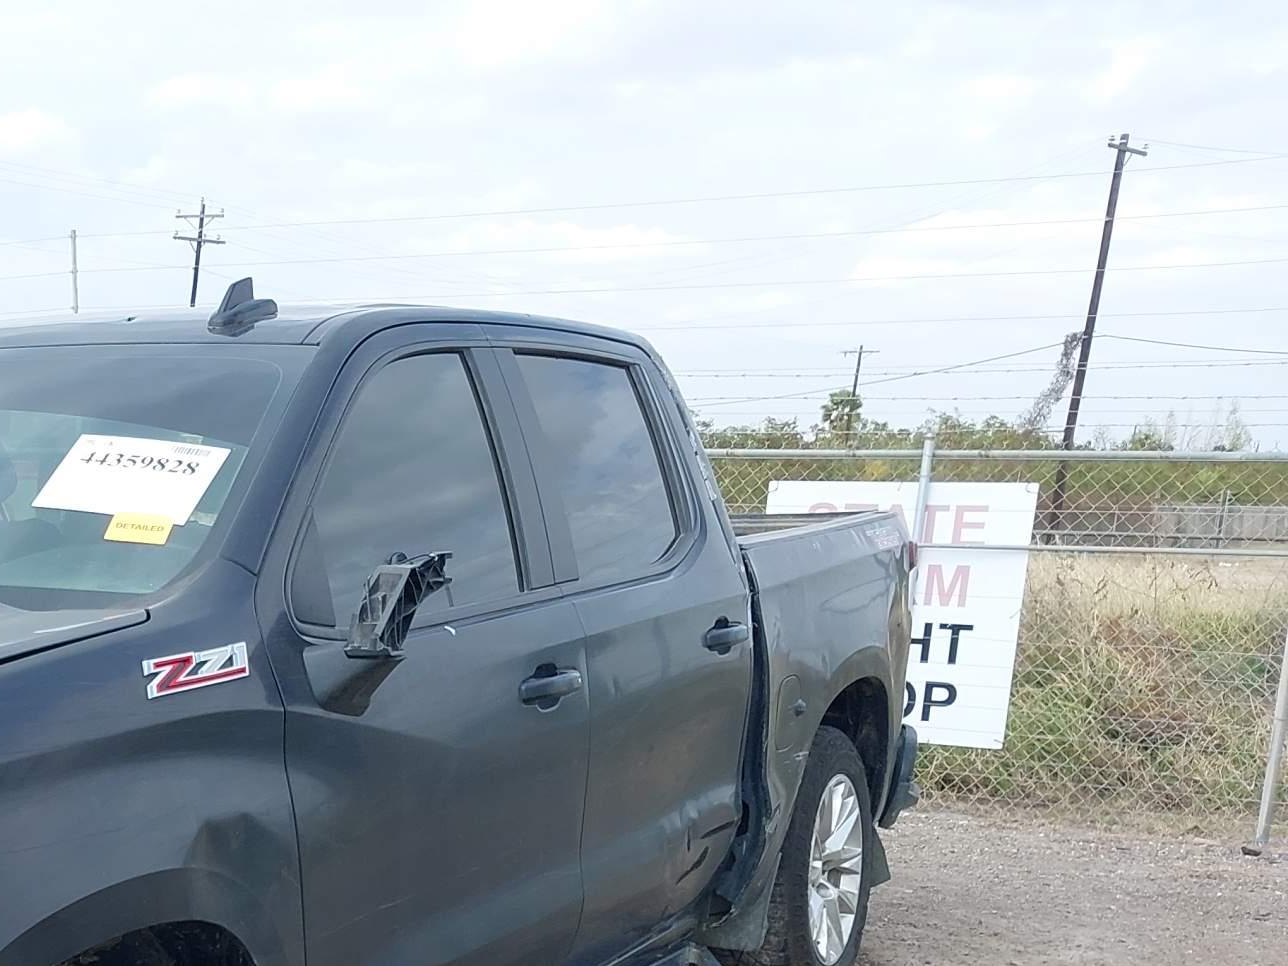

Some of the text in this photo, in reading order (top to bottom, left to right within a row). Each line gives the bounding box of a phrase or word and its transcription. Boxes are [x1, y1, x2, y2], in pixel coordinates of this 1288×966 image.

[80, 451, 200, 475] 44359828
[115, 521, 165, 532] DETAILED
[142, 641, 249, 700] Z71
